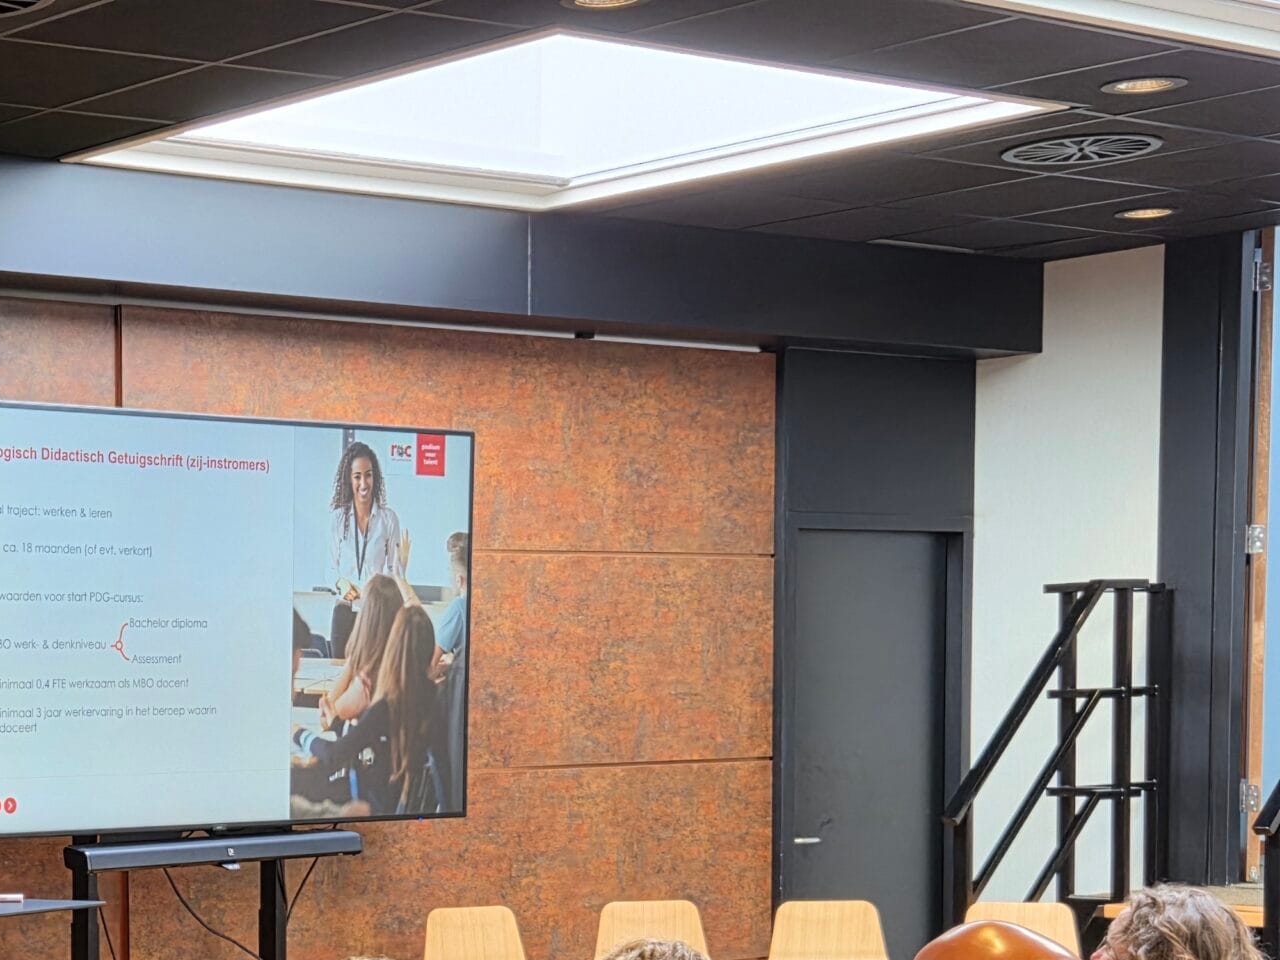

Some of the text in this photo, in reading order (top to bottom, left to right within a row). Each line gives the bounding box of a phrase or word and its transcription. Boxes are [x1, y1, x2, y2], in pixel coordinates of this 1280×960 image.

[41, 447, 104, 463] Didactisch
[108, 450, 183, 469] Getuigschrift
[186, 455, 270, 474] (zij-instromers)
[7, 504, 41, 519] traject:
[43, 506, 77, 518] werken
[79, 507, 87, 518] &
[89, 507, 113, 519] leren
[2, 543, 19, 553] ca.
[22, 542, 33, 553] 18
[35, 543, 82, 555] maanden
[84, 544, 97, 557] (of
[119, 545, 153, 558] verkort)
[44, 592, 65, 602] voor
[67, 591, 87, 602] start
[90, 591, 144, 603] PDG-cursus:
[129, 617, 208, 630] Bachelor diploma
[42, 638, 50, 650] &
[52, 638, 107, 650] denkniveau
[131, 653, 183, 665] Assessment
[52, 678, 67, 690] FTE
[70, 678, 116, 689] werkzaam
[118, 678, 131, 689] als
[132, 677, 155, 689] MBO
[156, 677, 190, 689] docent
[36, 707, 42, 718] 3
[43, 707, 62, 720] jaar
[64, 705, 124, 719] werkervaring
[125, 706, 134, 717] in
[135, 706, 151, 717] het
[152, 705, 186, 718] beroep
[188, 704, 218, 716] waarin
[0, 722, 38, 734] doceert
